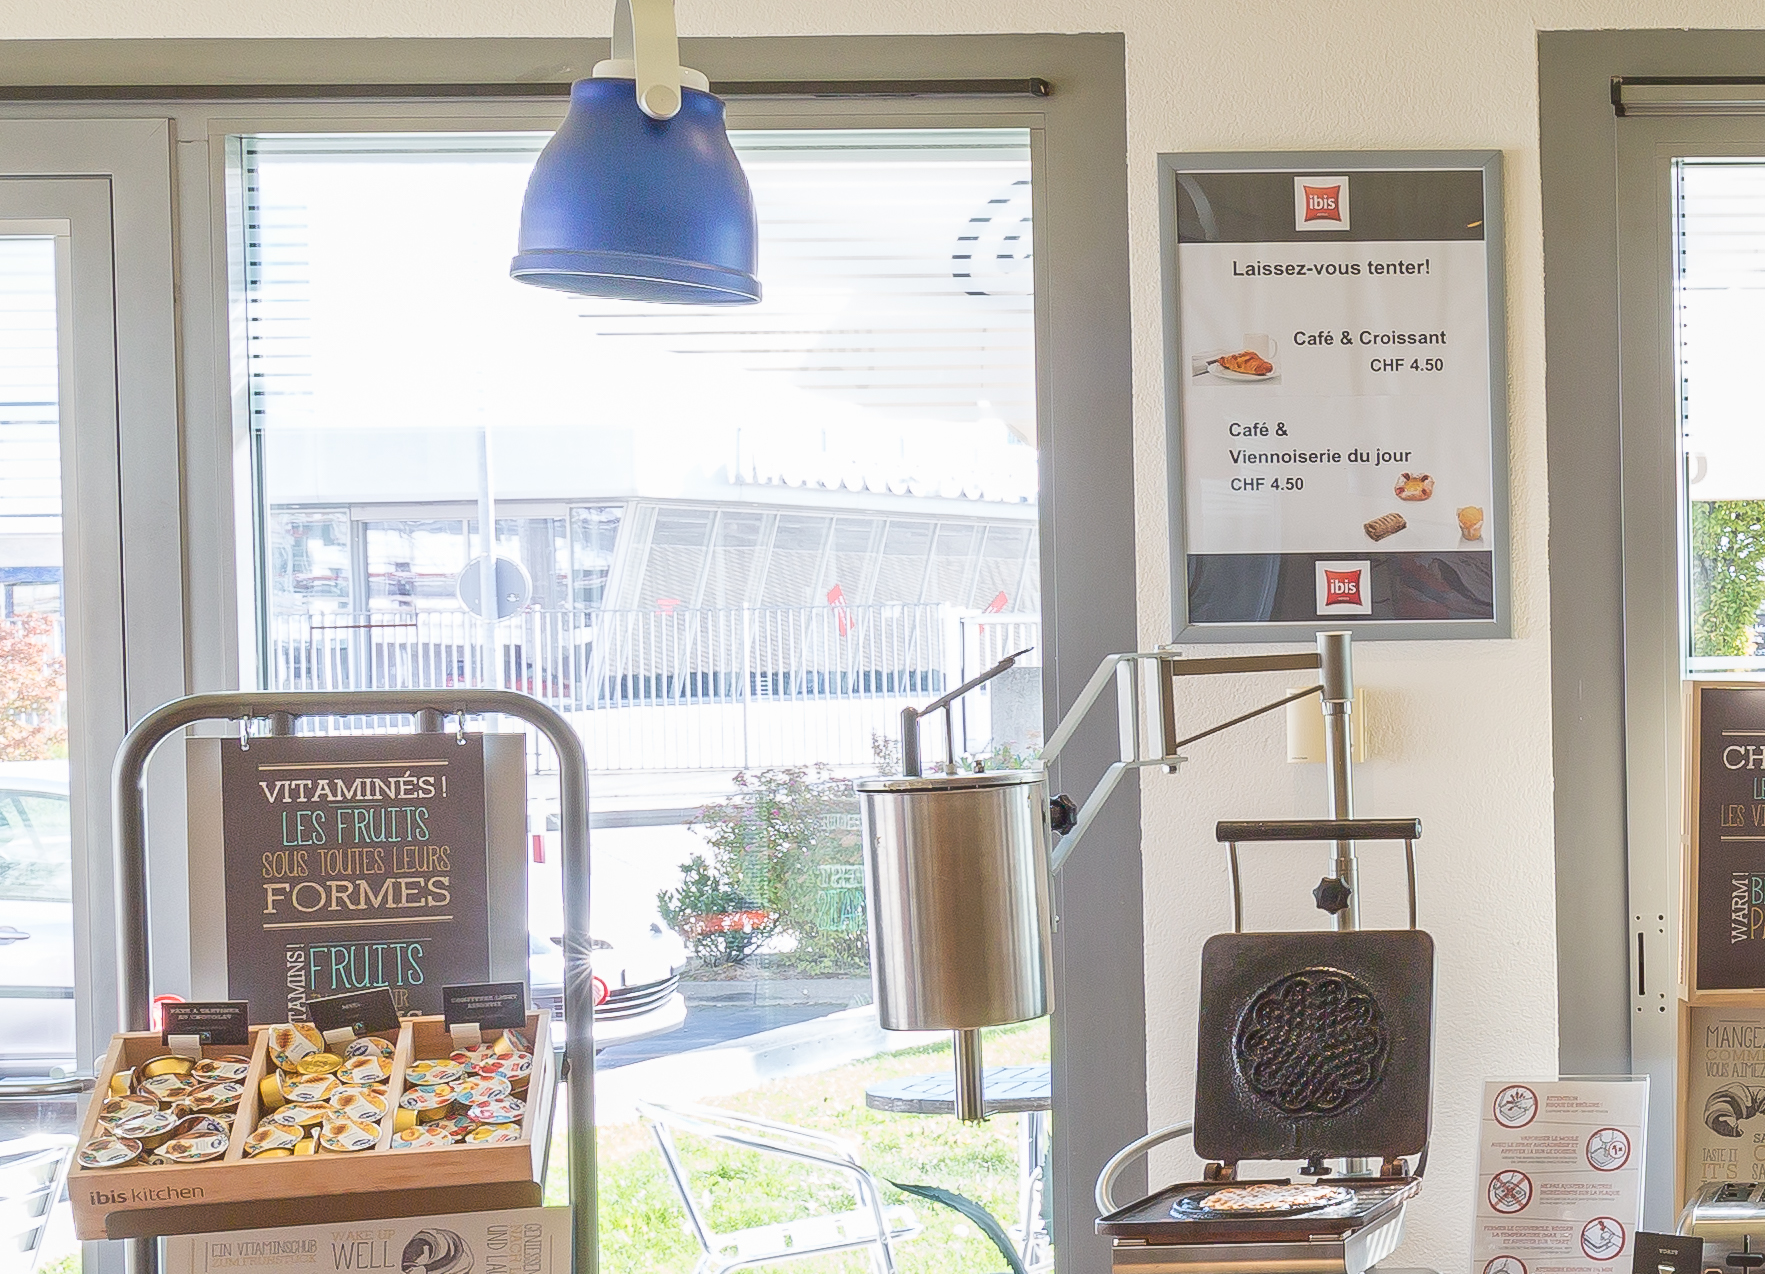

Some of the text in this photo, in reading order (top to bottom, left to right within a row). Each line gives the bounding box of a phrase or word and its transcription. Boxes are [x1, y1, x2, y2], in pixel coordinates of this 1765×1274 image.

[1308, 193, 1336, 211] ibis
[1232, 258, 1431, 277] Laissez-vous tenter!
[1293, 330, 1447, 346] Café & Croissant
[1370, 358, 1444, 373] CHF 4.50
[1229, 422, 1289, 437] Café &
[1229, 448, 1412, 467] Viennoiserie du jour
[1231, 477, 1304, 492] CHF 4.50
[1330, 579, 1357, 596] ibis
[1720, 804, 1745, 827] LES
[282, 807, 429, 846] LES FRUITS
[262, 846, 450, 878] SOUS TOUTES LEURS
[263, 877, 451, 914] FORMES
[309, 943, 424, 990] FRUITS
[1706, 1062, 1729, 1078] VOUS
[90, 1186, 204, 1206] ibis kitchen
[487, 1225, 508, 1250] UND
[332, 1241, 395, 1271] WELL
